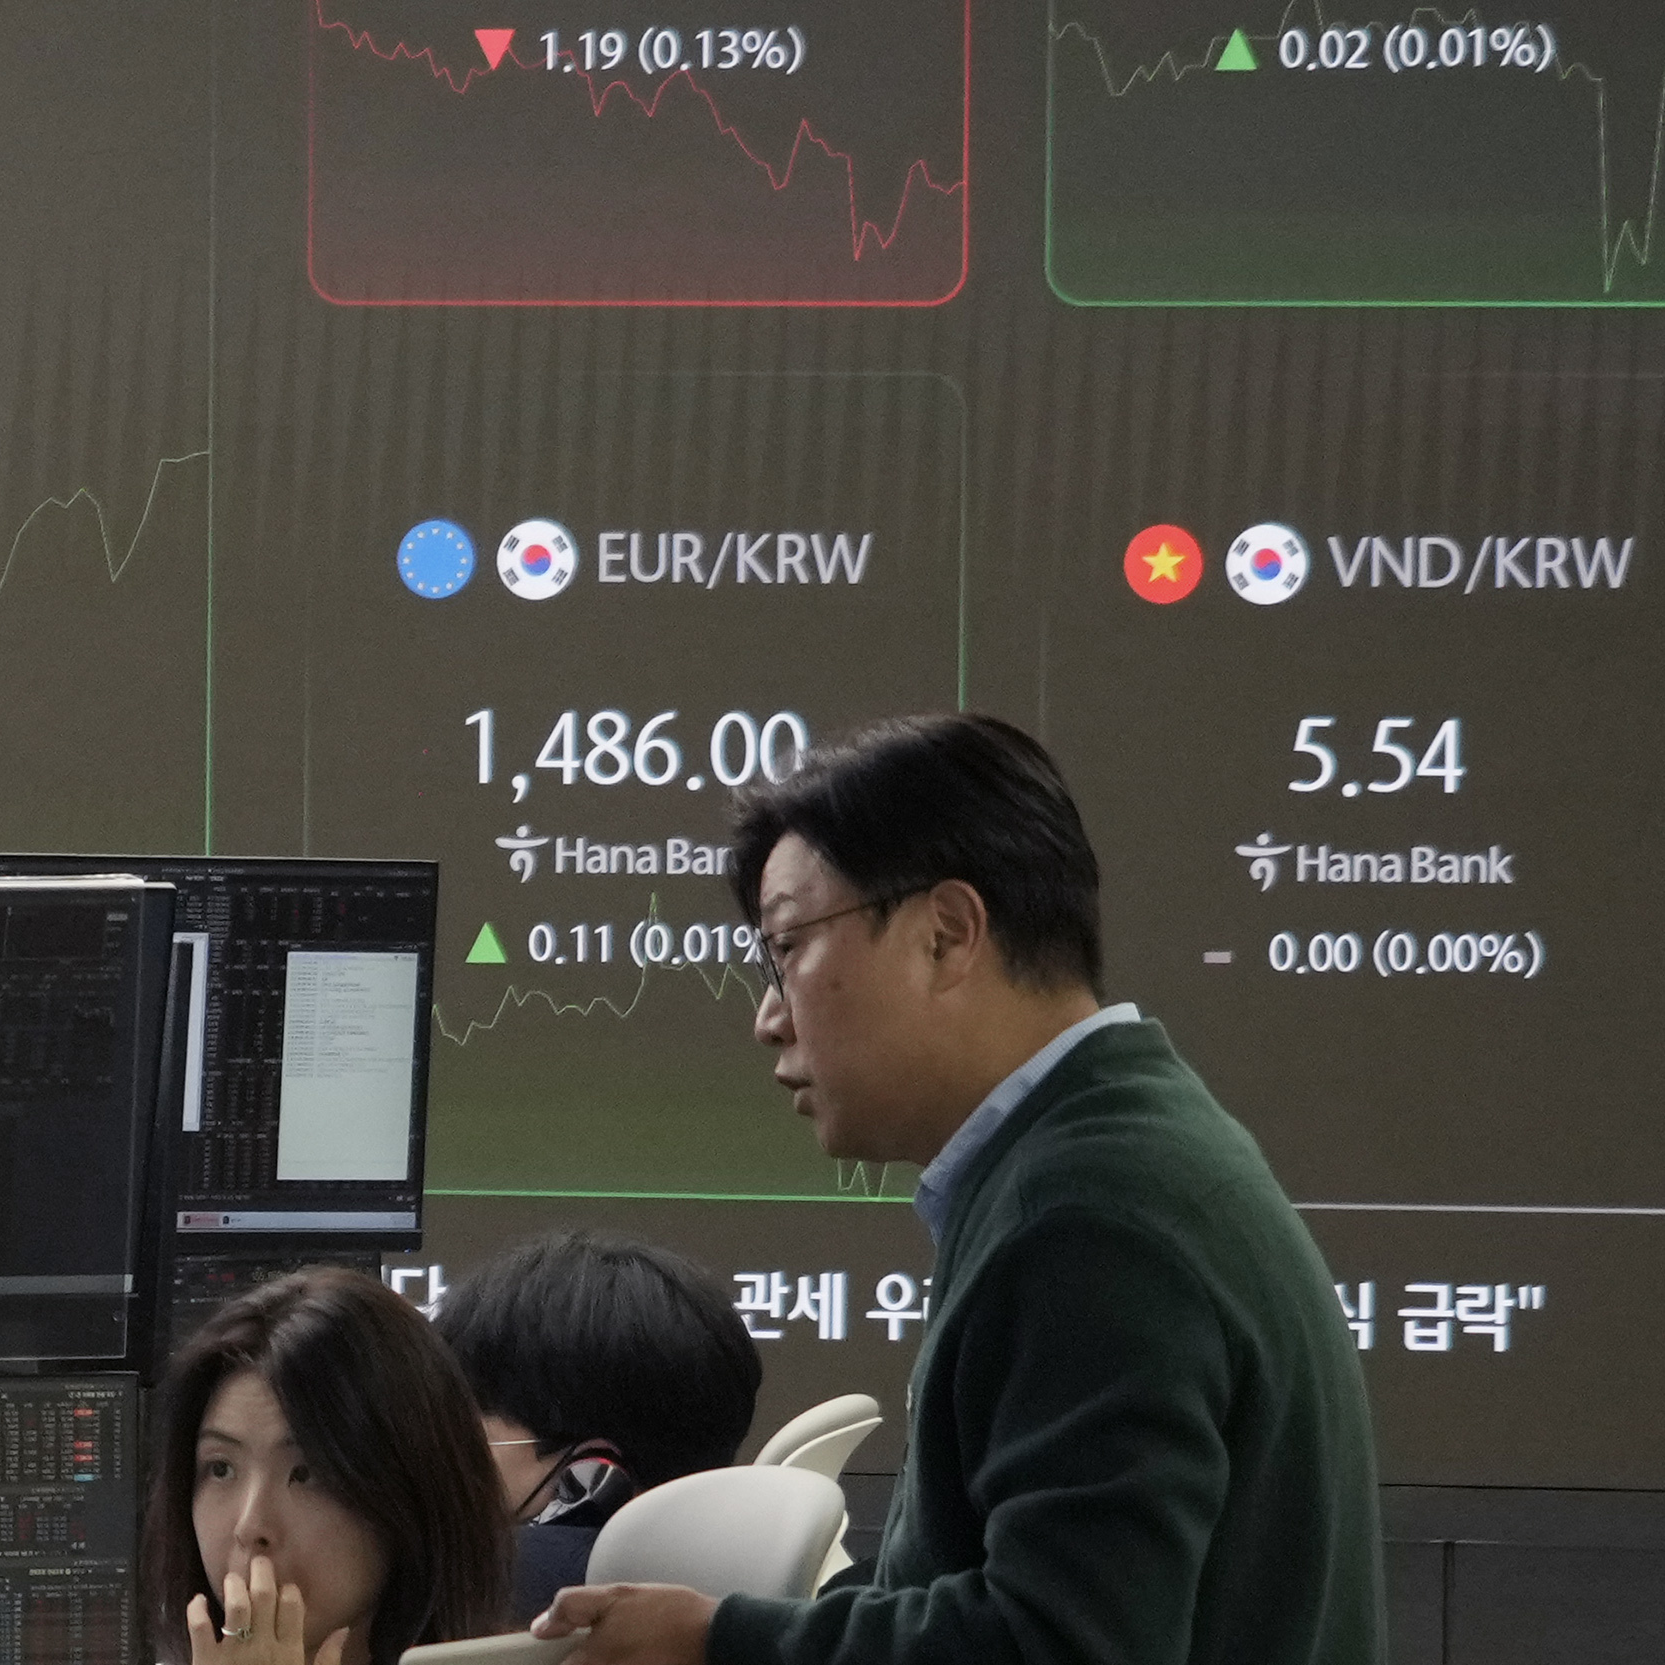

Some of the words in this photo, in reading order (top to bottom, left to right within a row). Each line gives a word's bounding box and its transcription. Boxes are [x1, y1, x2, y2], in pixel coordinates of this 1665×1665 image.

[540, 31, 625, 73] 1.19
[638, 27, 803, 76] (0.13%)
[1279, 29, 1369, 72] 0.02
[1383, 24, 1555, 74] (0.01%)
[597, 530, 873, 590] EUR/KRW
[1327, 534, 1635, 595] VND/KRW
[465, 710, 808, 804] 1,486.00
[1288, 718, 1466, 798] 5.54
[555, 837, 660, 875] Hana
[666, 838, 734, 875] Ban
[1296, 844, 1405, 883] Hana
[1410, 845, 1513, 884] Bank
[528, 924, 613, 965] 0.11
[629, 920, 762, 969] (0.01%
[1268, 932, 1360, 975] 0.00
[1373, 929, 1542, 979] (0.00%)
[381, 1264, 448, 1322] 다
[733, 1271, 848, 1340] 관세
[865, 1273, 933, 1341] 우
